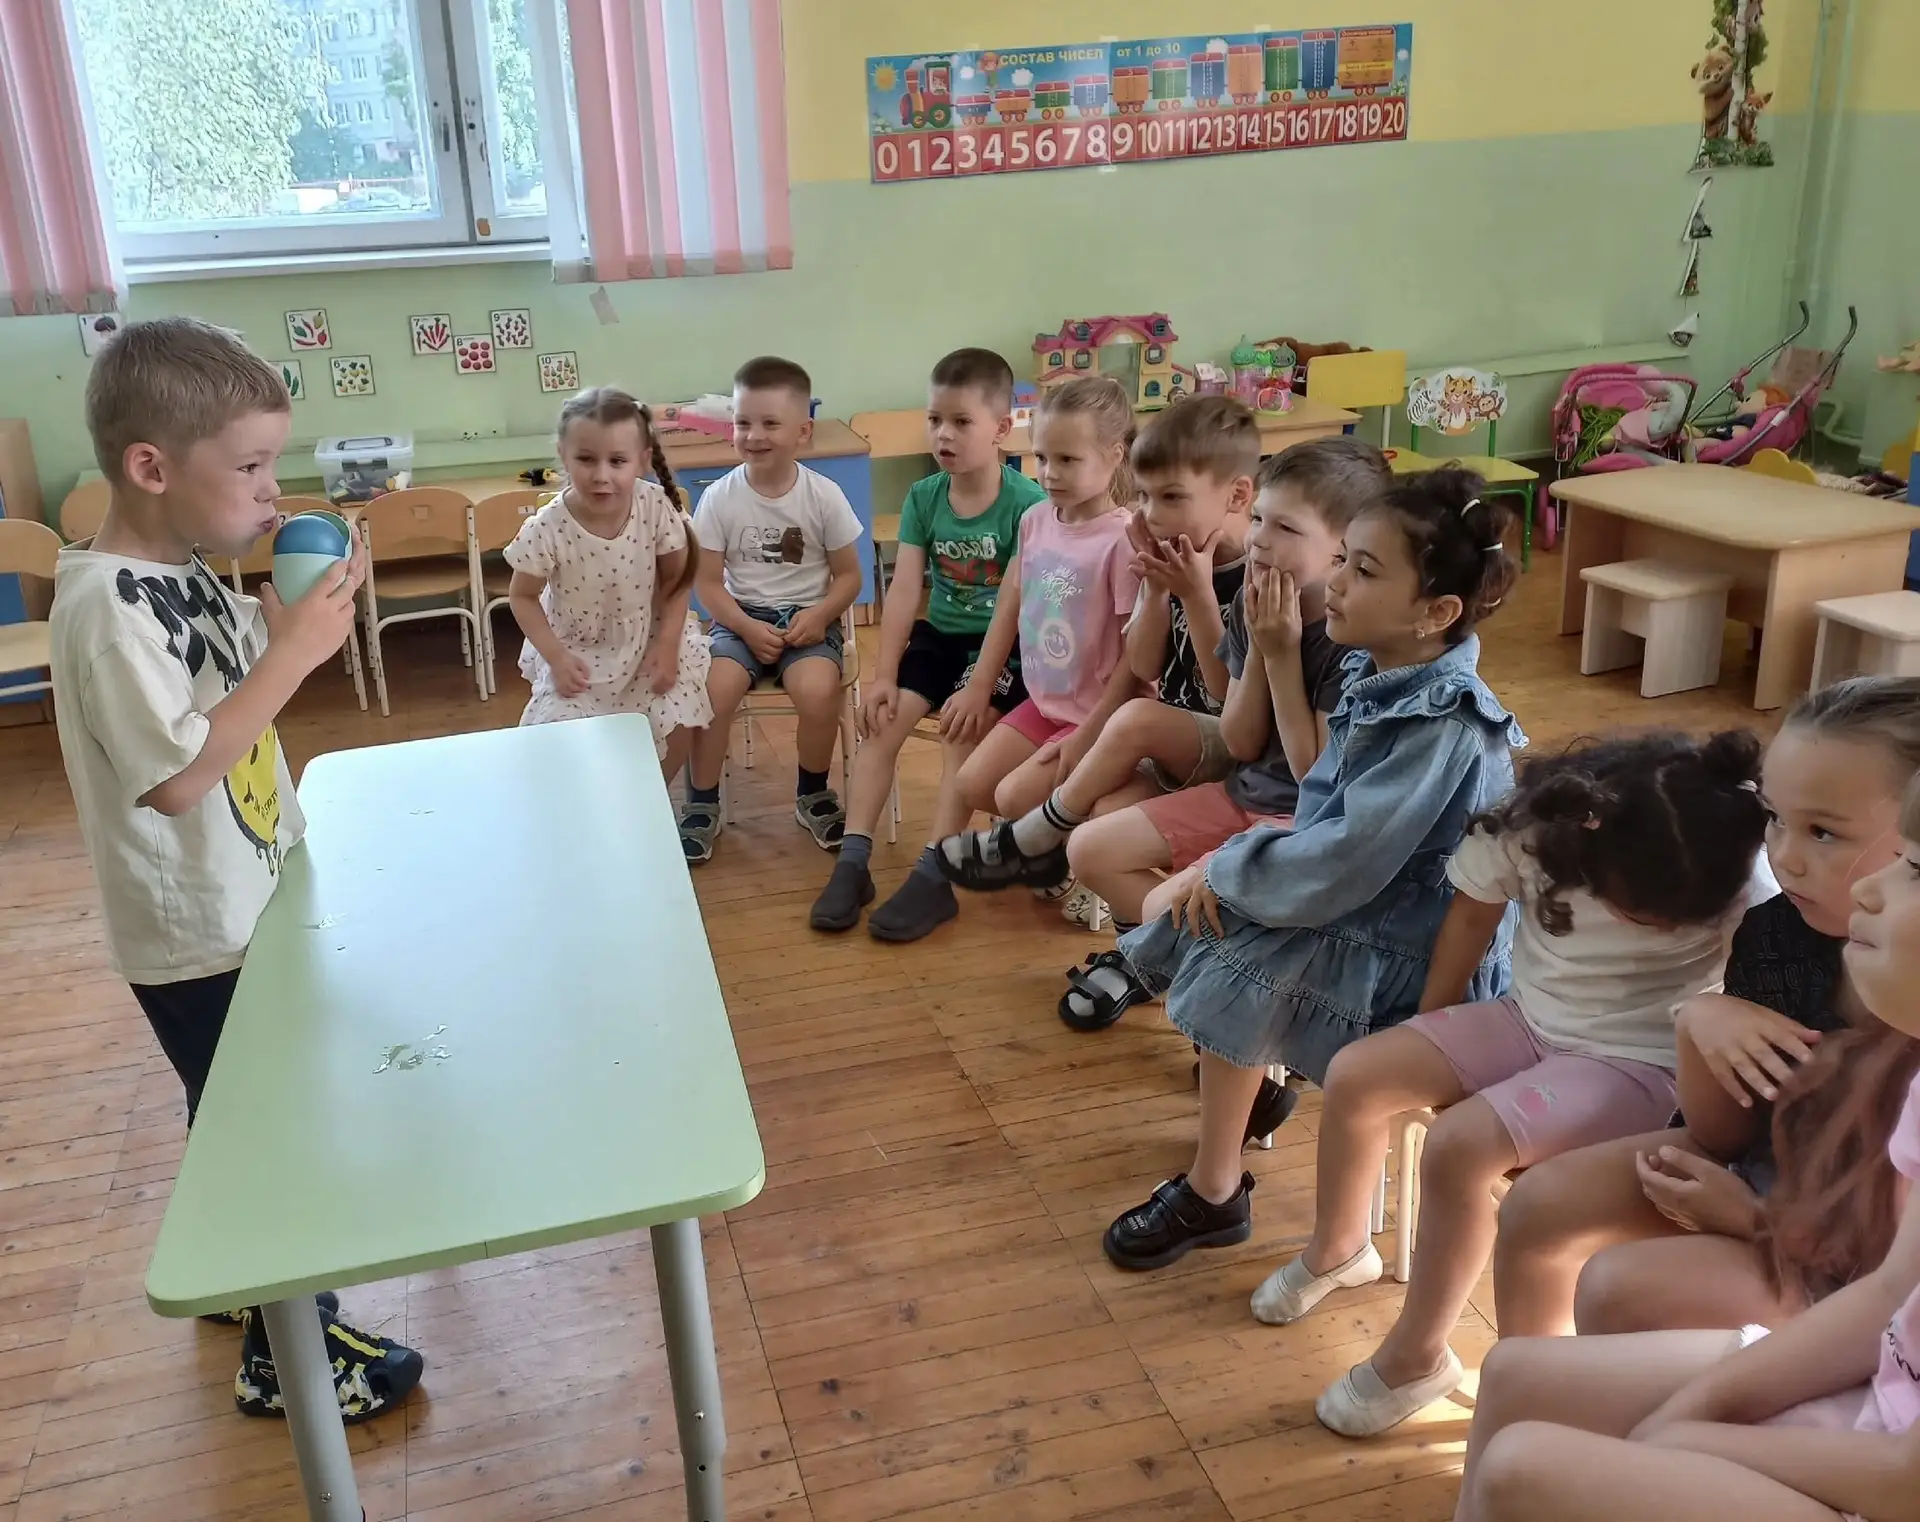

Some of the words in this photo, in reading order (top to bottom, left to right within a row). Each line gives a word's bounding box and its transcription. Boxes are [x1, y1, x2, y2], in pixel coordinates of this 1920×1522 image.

[1117, 48, 1131, 57] от
[1135, 45, 1142, 56] 1
[1146, 46, 1161, 57] до
[1167, 42, 1181, 54] 10
[1000, 52, 1054, 66] СОСТАВ
[1058, 48, 1104, 63] ЧИСЕЛ
[877, 141, 899, 174] 0
[907, 139, 922, 172] 1
[931, 137, 953, 171] 2
[958, 134, 978, 168] 3
[982, 133, 1005, 166] 4
[1011, 130, 1030, 164] 5
[1035, 128, 1057, 162] 6
[1062, 127, 1081, 160] 7
[1087, 124, 1106, 158] 8
[1112, 122, 1134, 156] 9
[1138, 120, 1162, 154] 10
[1164, 119, 1186, 151] 11
[1189, 116, 1212, 150] 12
[1213, 114, 1236, 147] 13
[1239, 112, 1261, 146] 14
[1263, 110, 1286, 143] 15
[1287, 108, 1310, 141] 16
[1311, 107, 1335, 140] 17
[1336, 104, 1358, 138] 18
[1360, 103, 1382, 136] 19
[1382, 102, 1405, 134] 20
[288, 314, 296, 323] 5
[493, 313, 500, 322] 9
[413, 318, 420, 327] 7
[457, 338, 464, 347] 8
[333, 360, 340, 369] 6
[541, 356, 552, 365] 10
